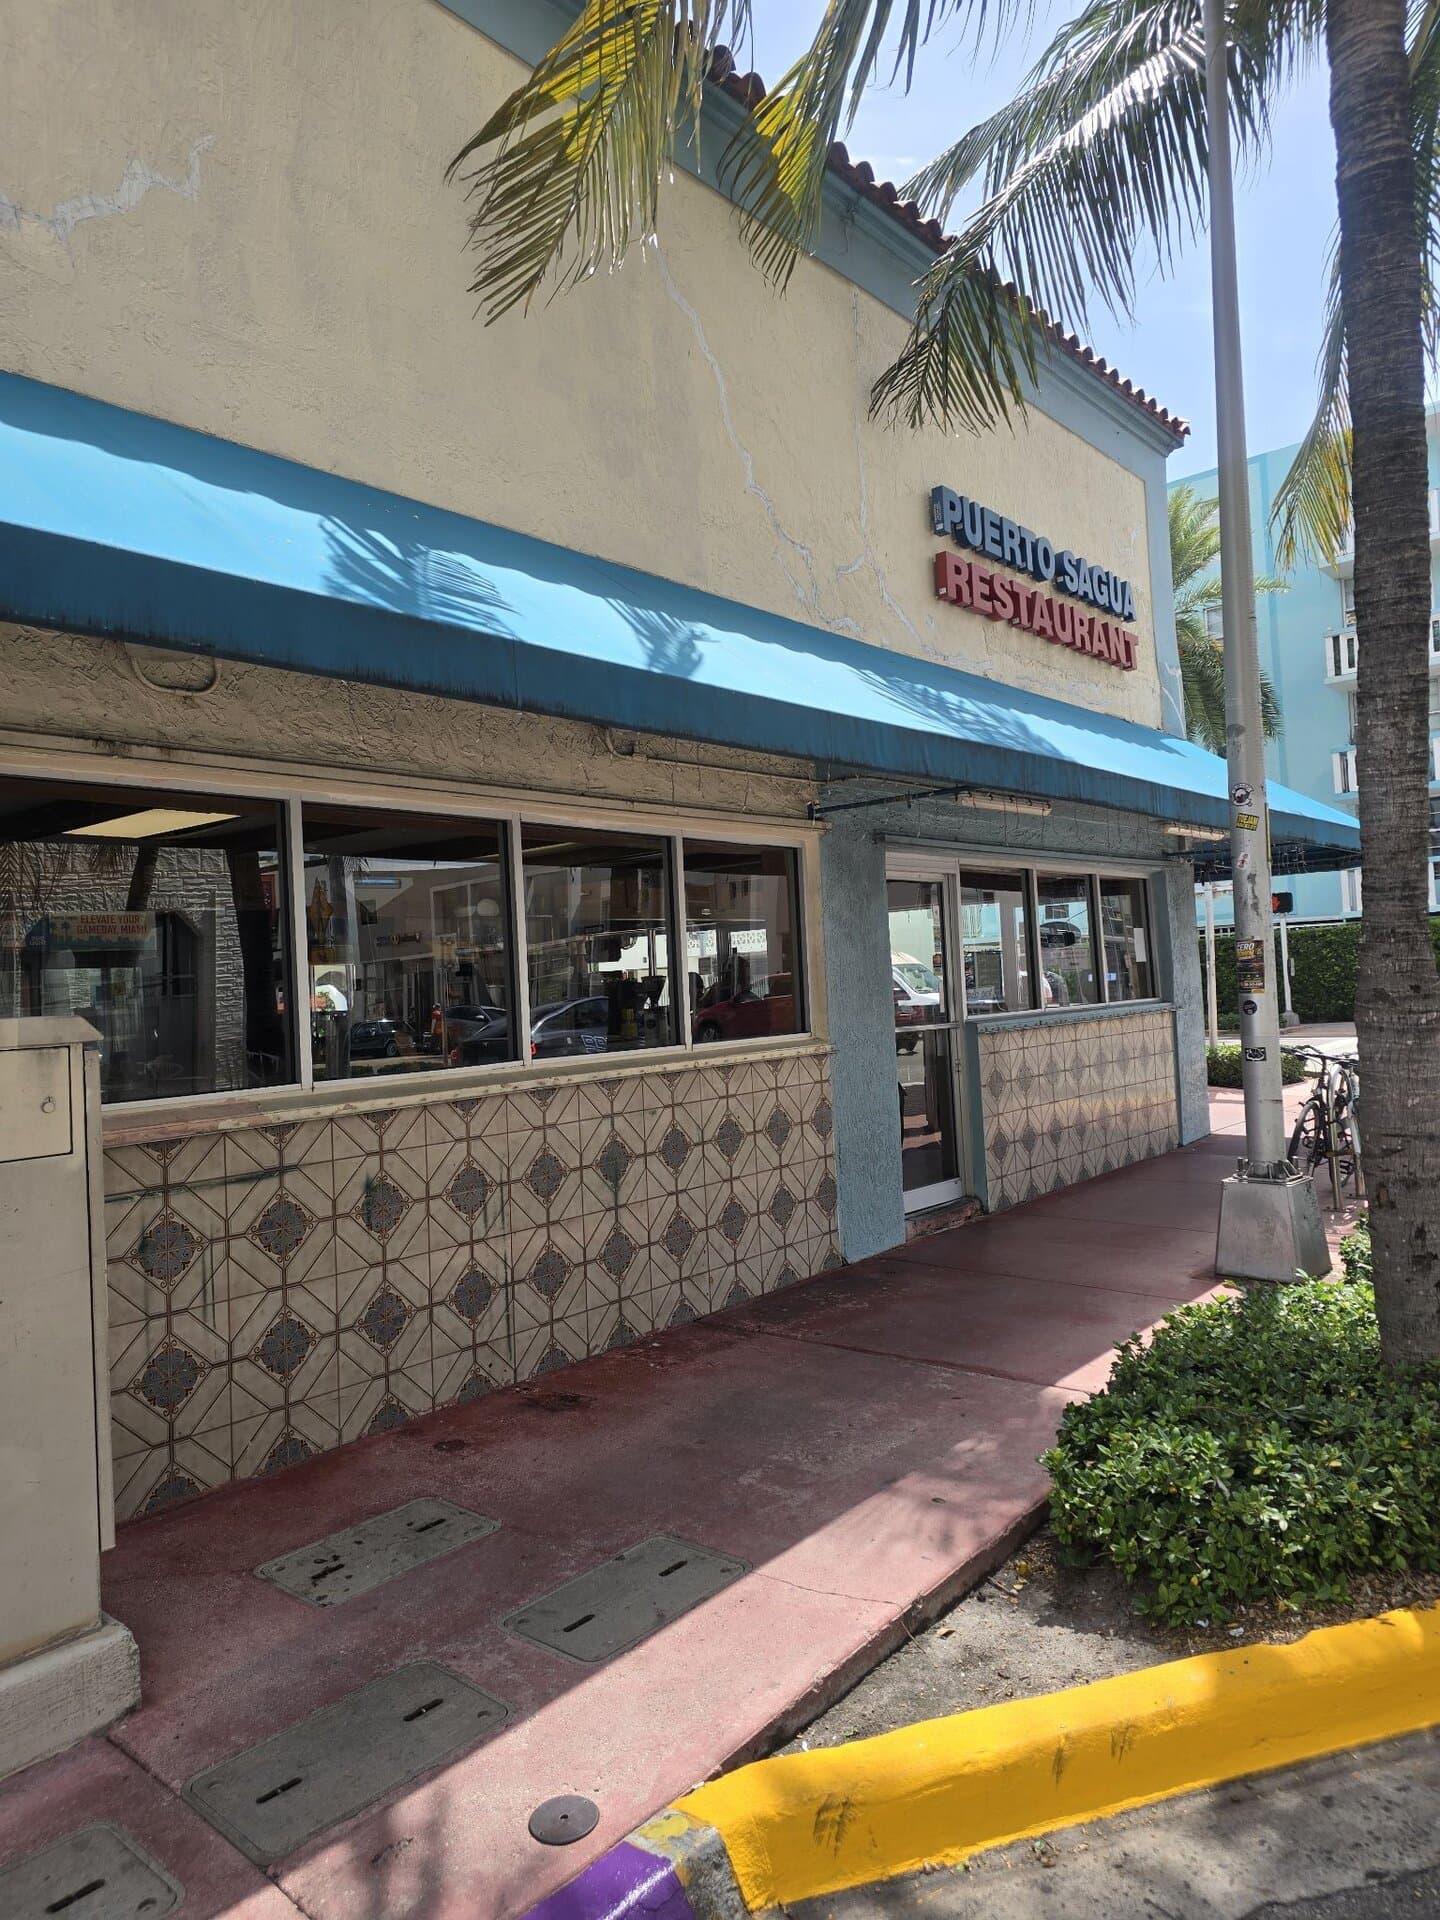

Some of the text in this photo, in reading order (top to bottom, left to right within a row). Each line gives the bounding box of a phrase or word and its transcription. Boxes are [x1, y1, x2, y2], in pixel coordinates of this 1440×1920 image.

[931, 485, 1137, 623] PUERTO SAGUA
[935, 551, 1139, 672] RESTAURANT
[80, 914, 141, 924] ELEVATE YOUR
